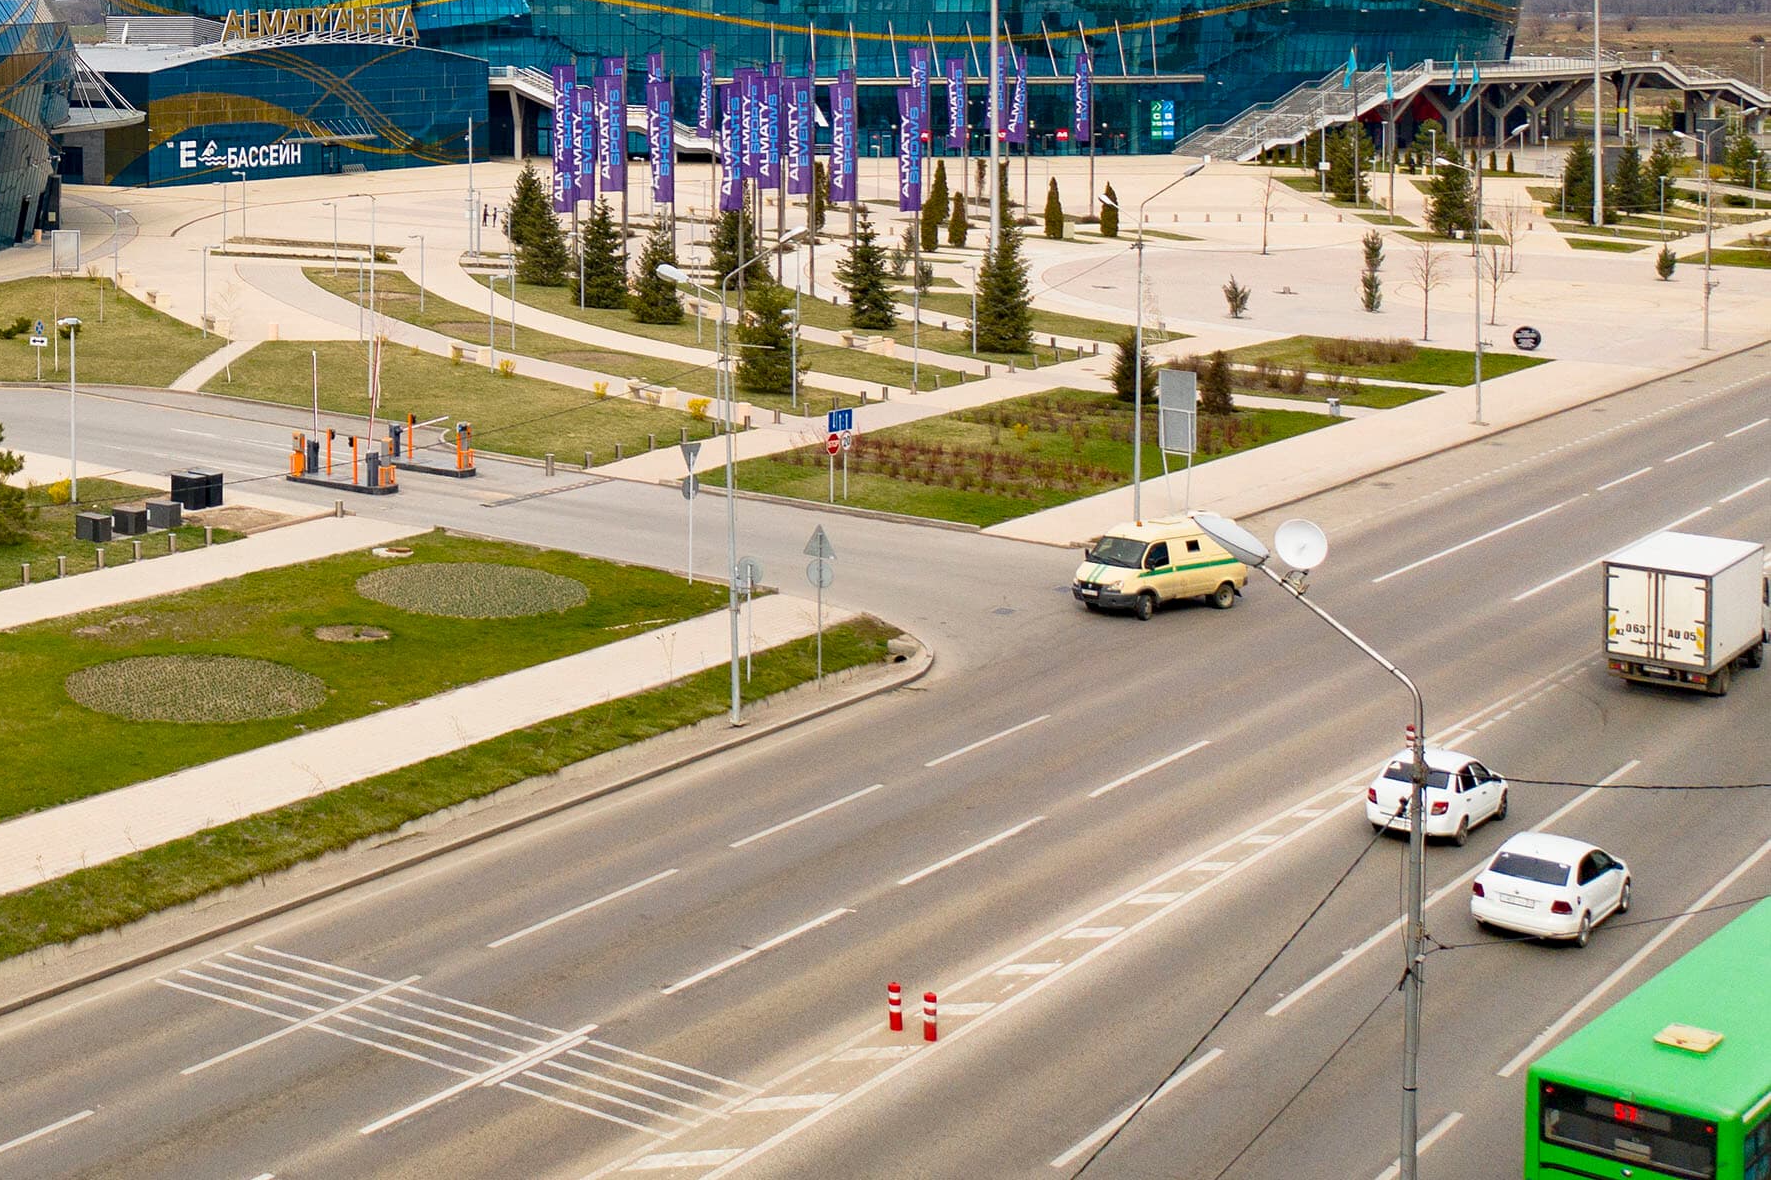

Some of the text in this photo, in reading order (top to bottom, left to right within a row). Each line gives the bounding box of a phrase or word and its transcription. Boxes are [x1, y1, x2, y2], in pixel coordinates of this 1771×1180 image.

[221, 7, 419, 43] ALMATY ARENA
[555, 89, 564, 161] ALMATY
[609, 89, 621, 166] SPORTS
[698, 70, 708, 129] ALMATY
[742, 95, 752, 166] ALMATY
[750, 84, 761, 154] SPORTS
[769, 93, 779, 164] SHOWS
[798, 90, 809, 167] EVENTS
[842, 97, 853, 174] SPORTS
[947, 78, 957, 138] ALMATY
[955, 68, 963, 128] SPORTS
[1007, 75, 1024, 133] ALMATY
[227, 139, 302, 169] БАССЕЙН
[571, 113, 582, 188] ALMATY
[582, 100, 592, 174] EVENTS
[599, 101, 611, 180] ALMATY
[650, 109, 660, 190] ALMATY
[659, 100, 670, 176] SHOWS
[721, 112, 731, 196] ALMATY
[730, 96, 740, 180] EVENTS
[759, 101, 770, 177] ALMATY
[787, 102, 799, 181] ALMATY
[833, 110, 844, 189] ALMATY
[900, 114, 910, 198] ALMATY
[909, 106, 919, 184] SHOWS
[1625, 623, 1646, 635] 063
[1683, 630, 1697, 641] 05
